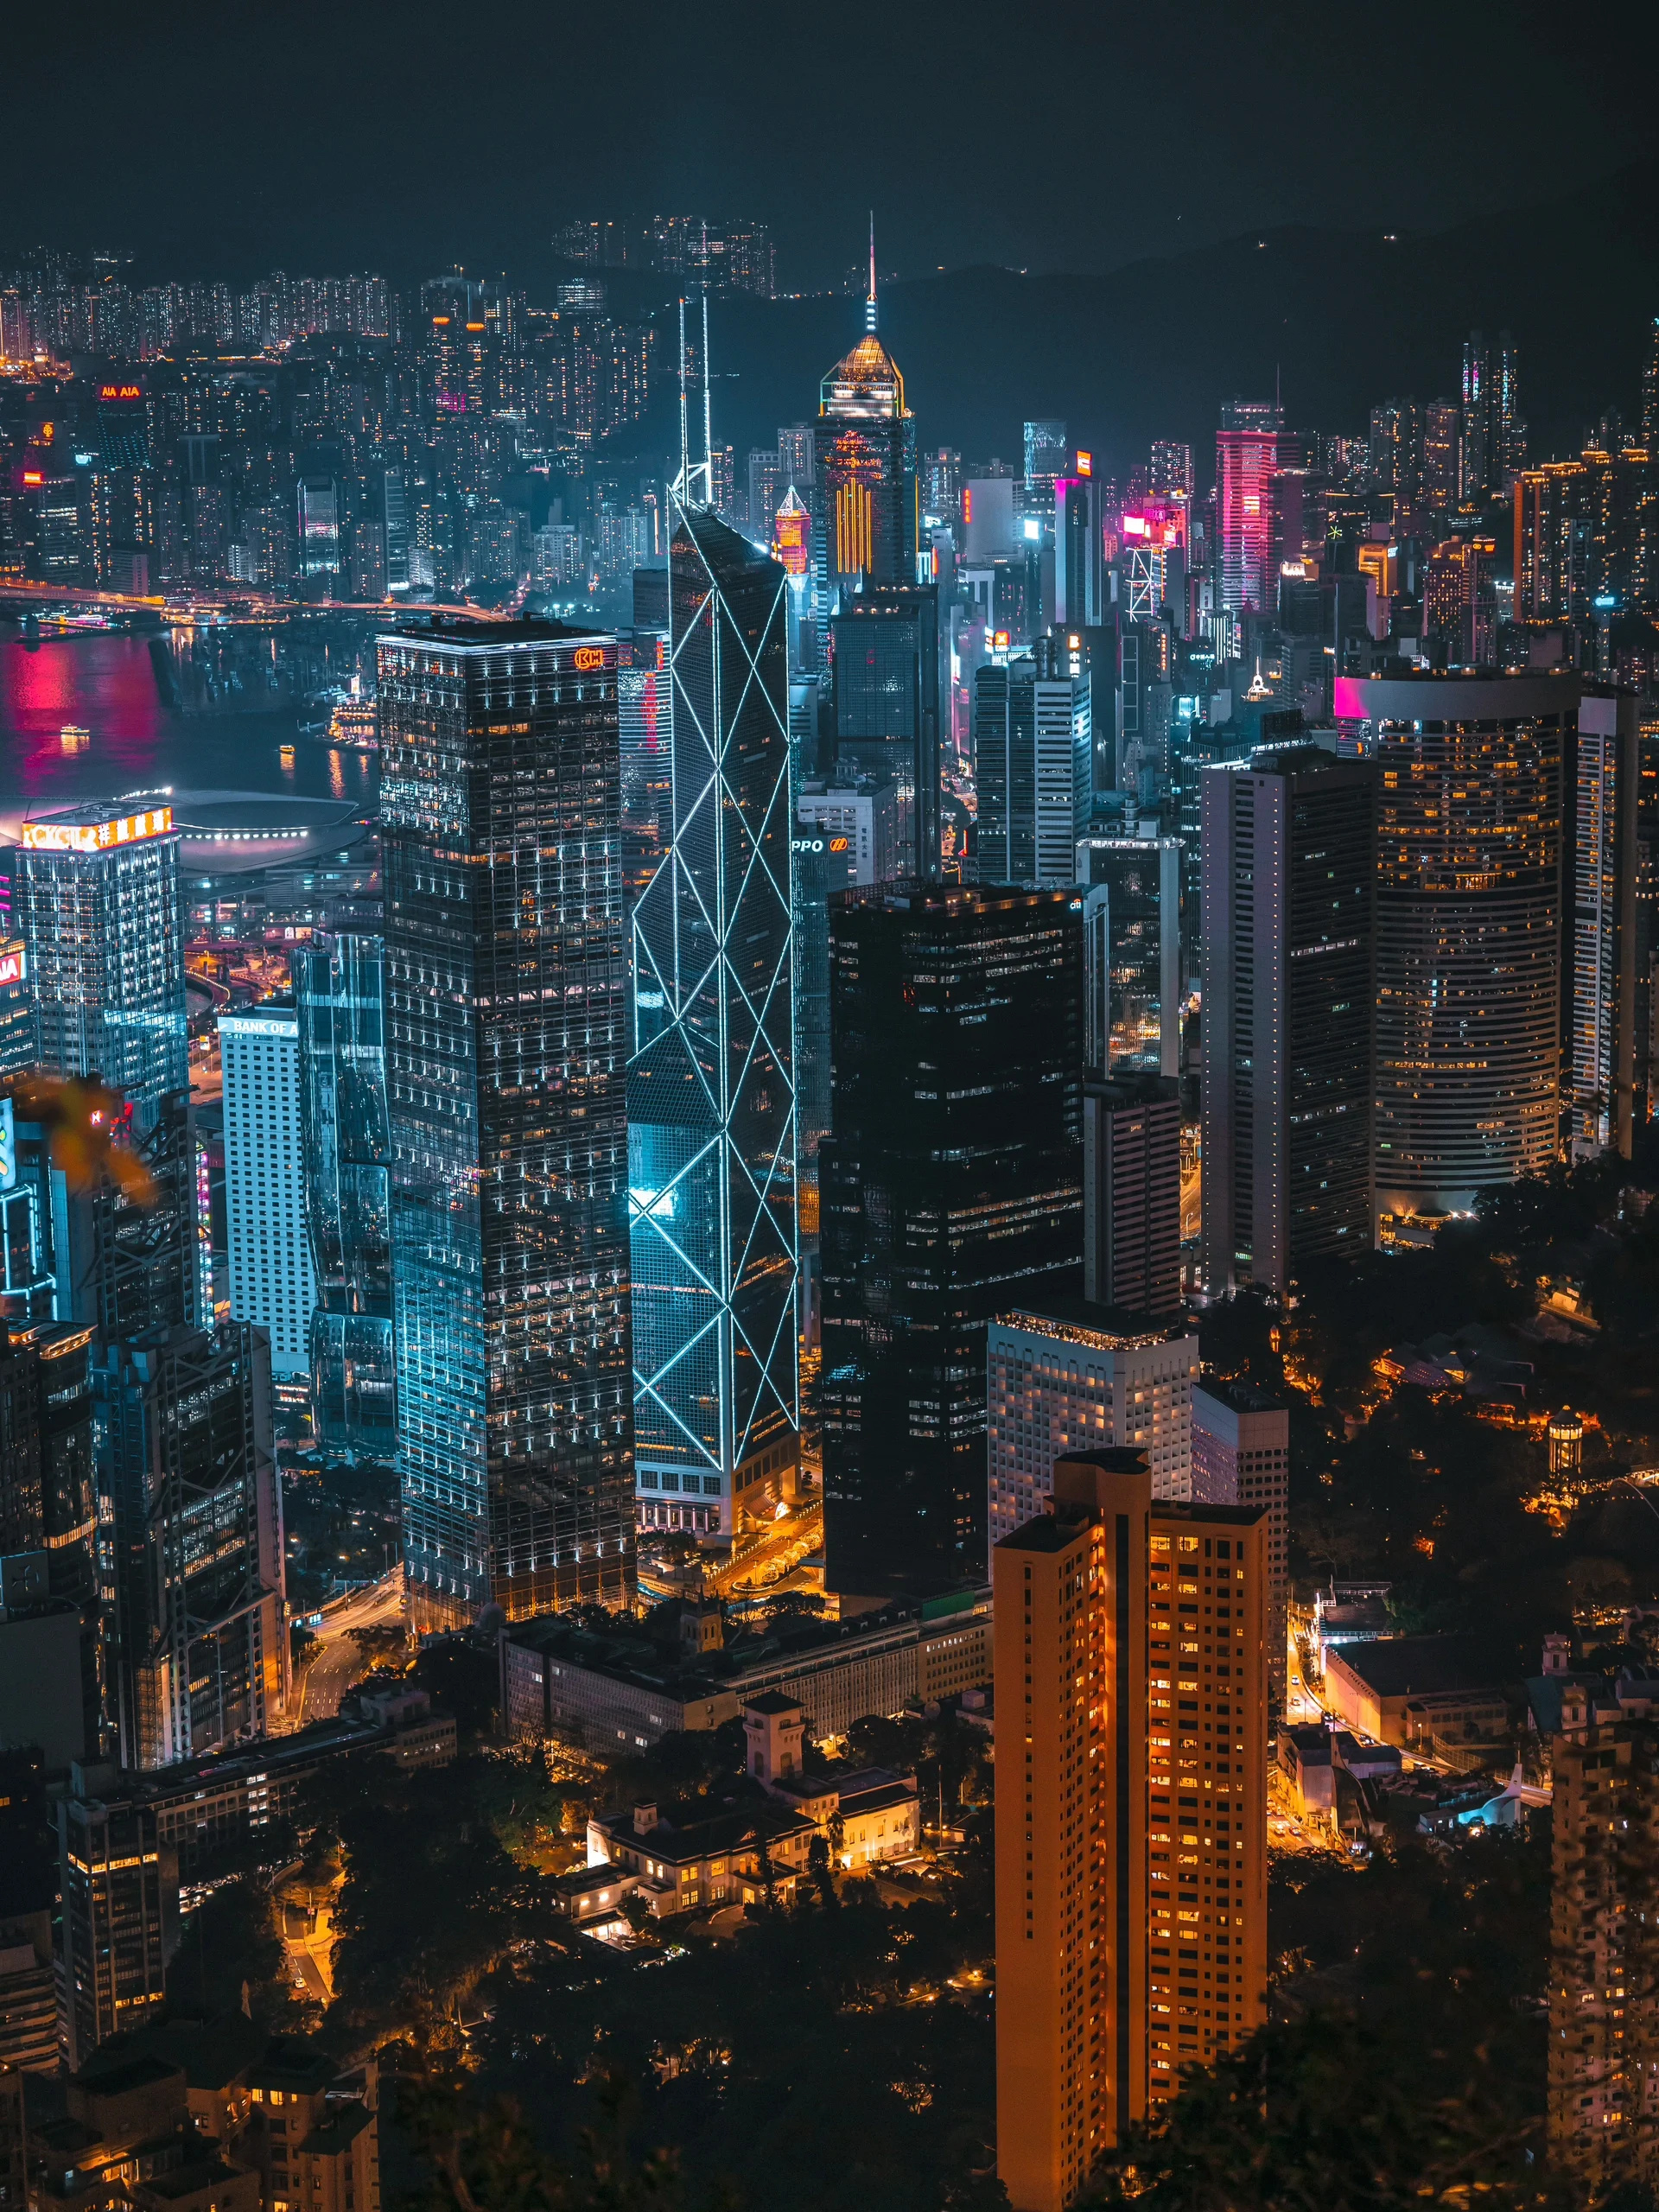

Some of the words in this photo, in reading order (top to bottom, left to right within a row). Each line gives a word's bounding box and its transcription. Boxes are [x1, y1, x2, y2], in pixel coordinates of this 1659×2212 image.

[102, 386, 116, 397] AIA
[120, 386, 139, 397] AIA
[233, 1020, 267, 1033] BANK
[270, 1022, 286, 1033] OF
